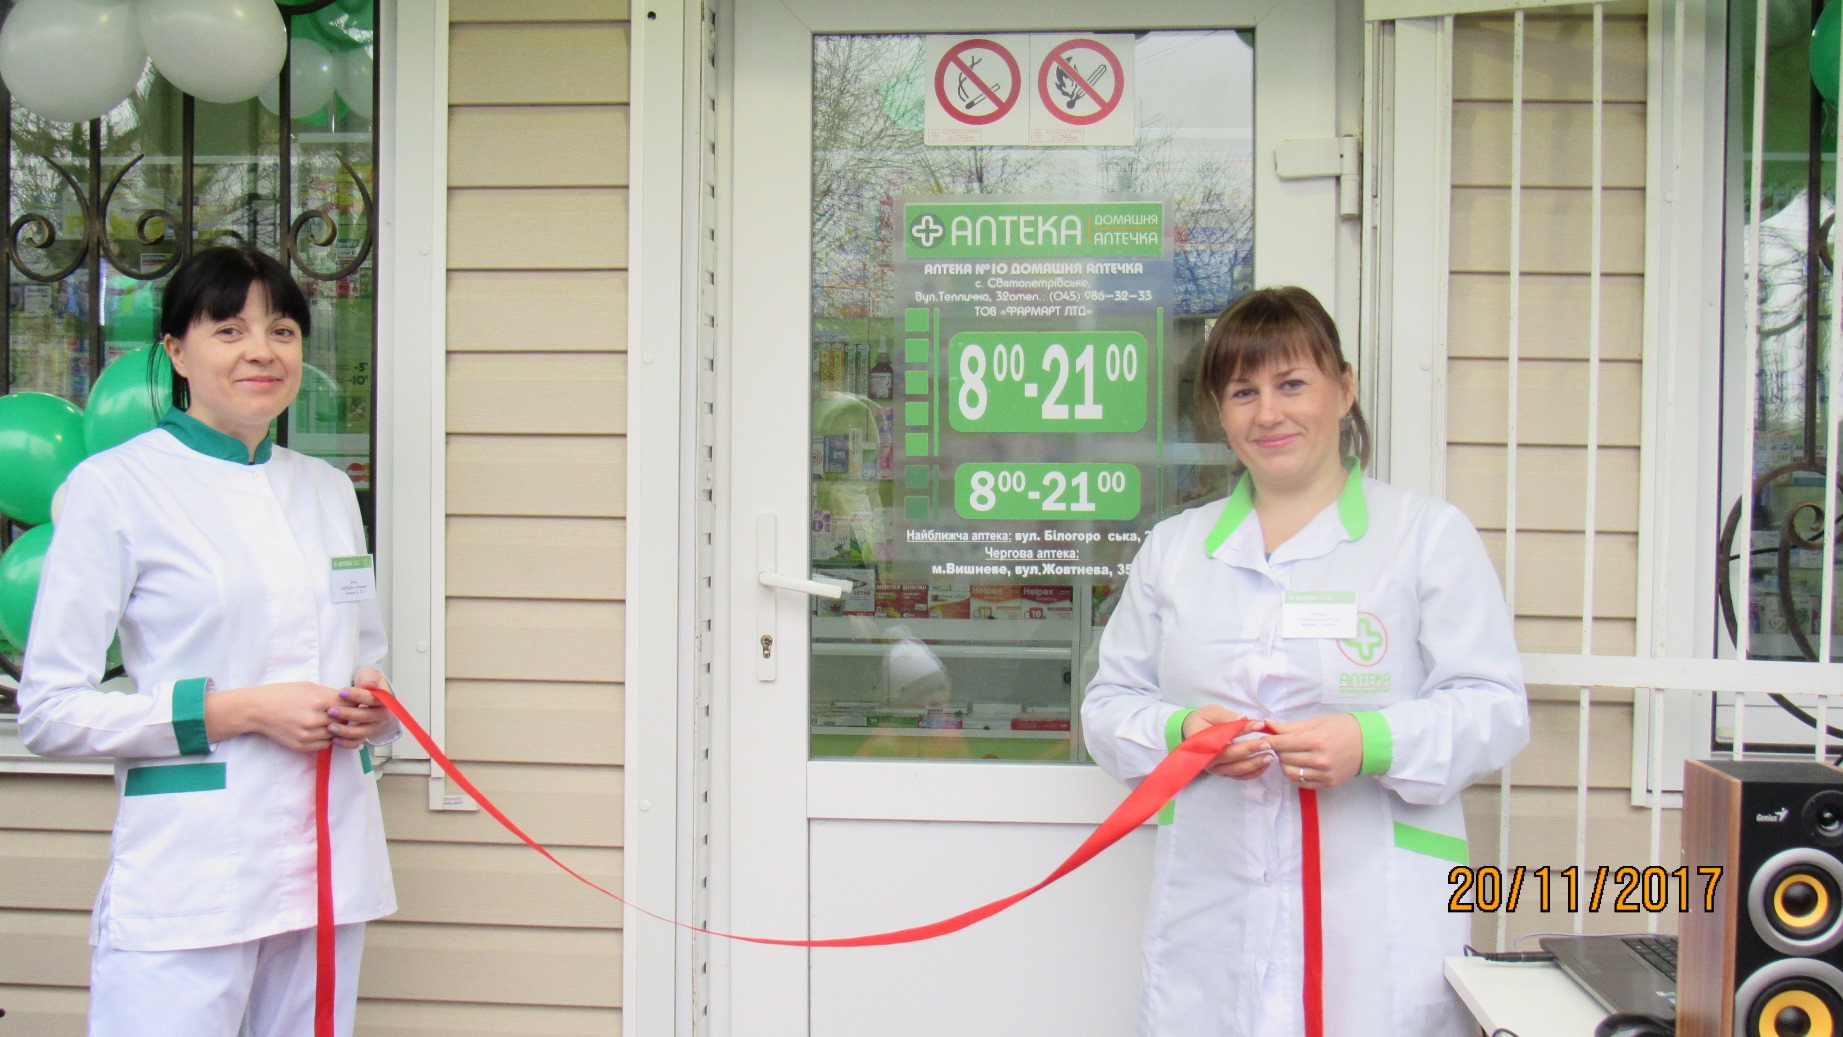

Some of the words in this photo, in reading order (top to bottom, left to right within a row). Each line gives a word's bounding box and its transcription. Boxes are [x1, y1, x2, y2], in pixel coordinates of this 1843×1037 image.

[1094, 214, 1158, 226] ДОМАШНЯ
[951, 215, 1082, 246] АПТЕКА
[1094, 232, 1158, 246] АПТЕЧКА
[924, 263, 972, 275] АПТЕКА
[1010, 262, 1082, 275] ДОМАШНЯ
[1086, 262, 1144, 274] АПТЕЧКА
[1049, 290, 1081, 302] (045)
[1084, 289, 1153, 301] 986-32-33
[974, 306, 997, 317] ТОВ
[906, 529, 969, 542] Найближча
[971, 532, 1013, 542] аптека:
[1014, 532, 1040, 544] вул.
[984, 546, 1034, 560] Чергова
[1036, 549, 1080, 560] аптека:
[931, 562, 1012, 577] м.Вишневе,
[1031, 609, 1042, 618] 10
[1756, 813, 1778, 822] Genius
